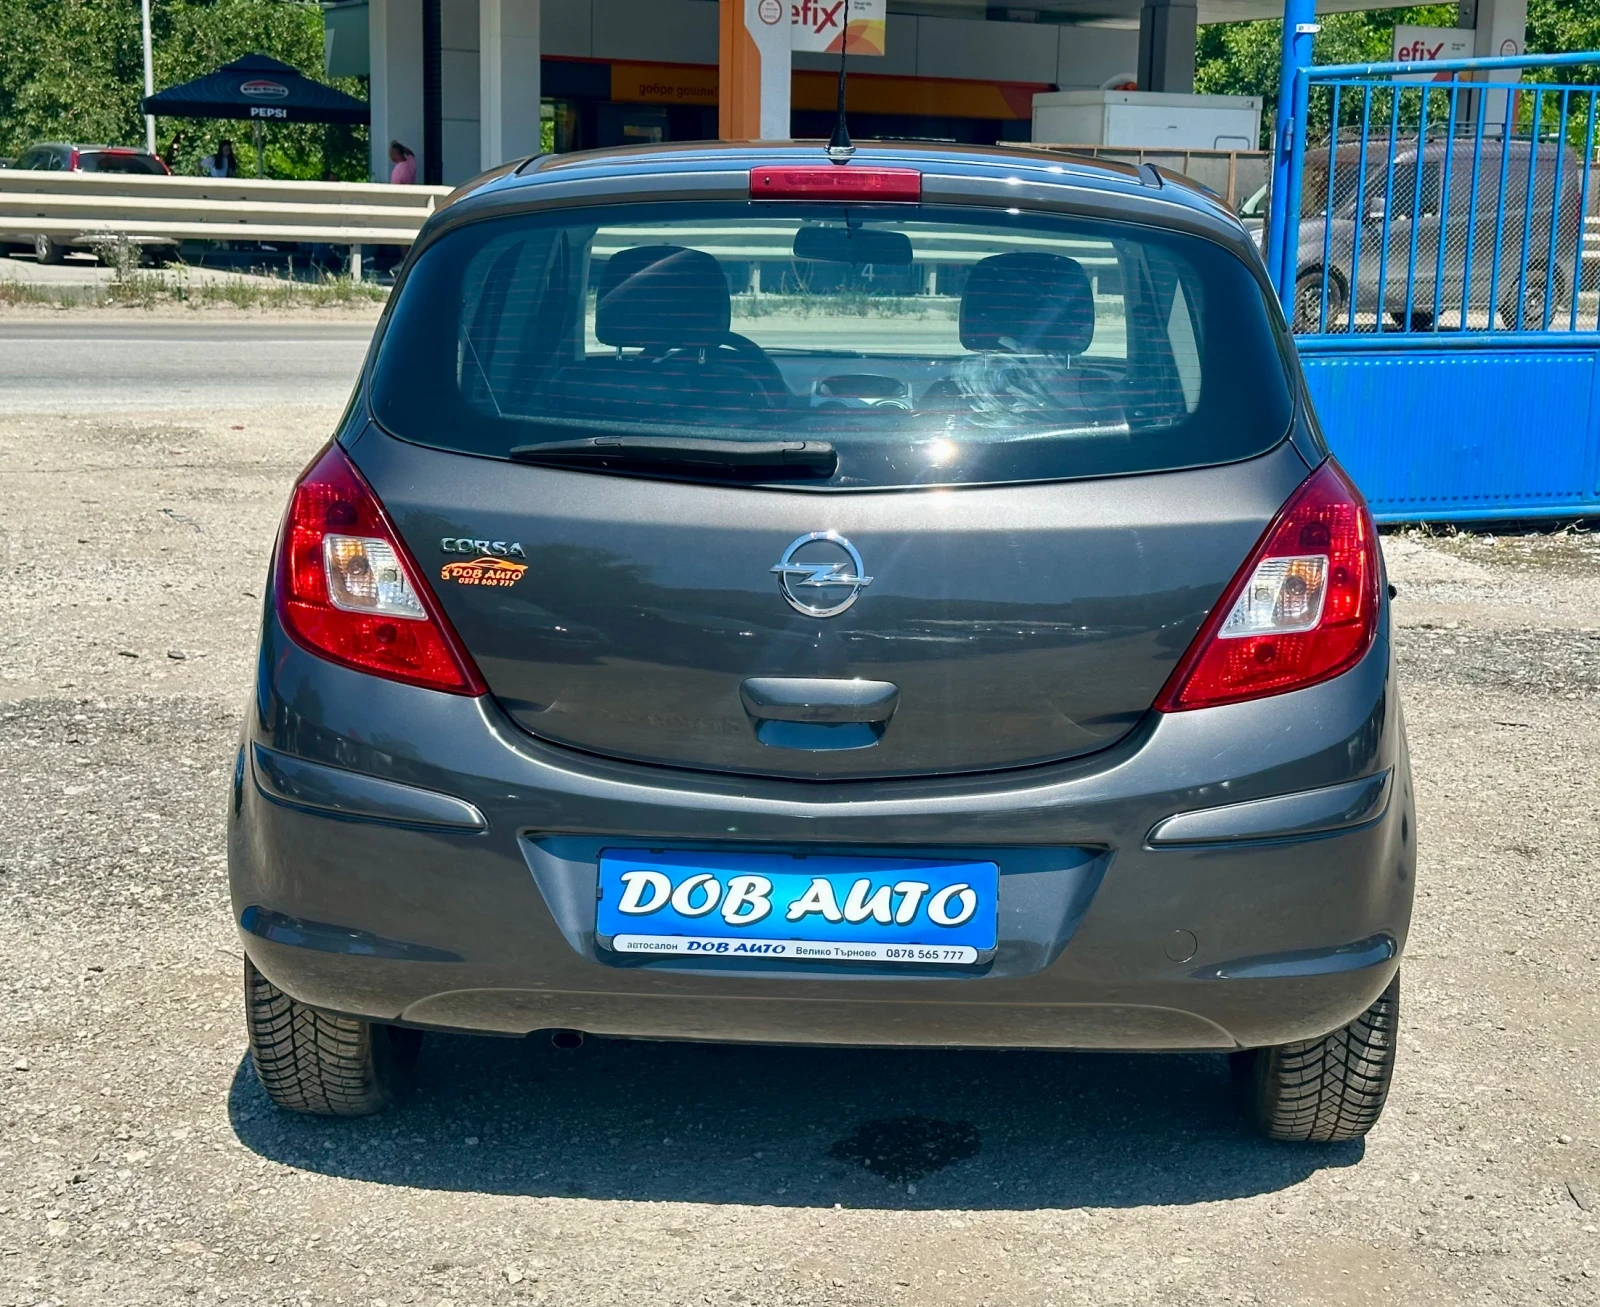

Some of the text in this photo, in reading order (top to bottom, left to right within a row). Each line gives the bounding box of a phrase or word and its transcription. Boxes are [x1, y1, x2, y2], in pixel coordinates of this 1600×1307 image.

[792, 0, 844, 34] efix
[1398, 41, 1444, 61] efix
[639, 83, 673, 96] добре
[251, 107, 287, 118] PEPSI
[861, 263, 875, 282] 4
[441, 537, 526, 558] CORSA
[452, 568, 482, 579] DOB
[618, 871, 978, 928] DOB AUTO
[627, 941, 964, 960] автосалон DOB AUTO Велико Търново 0878 565 777
